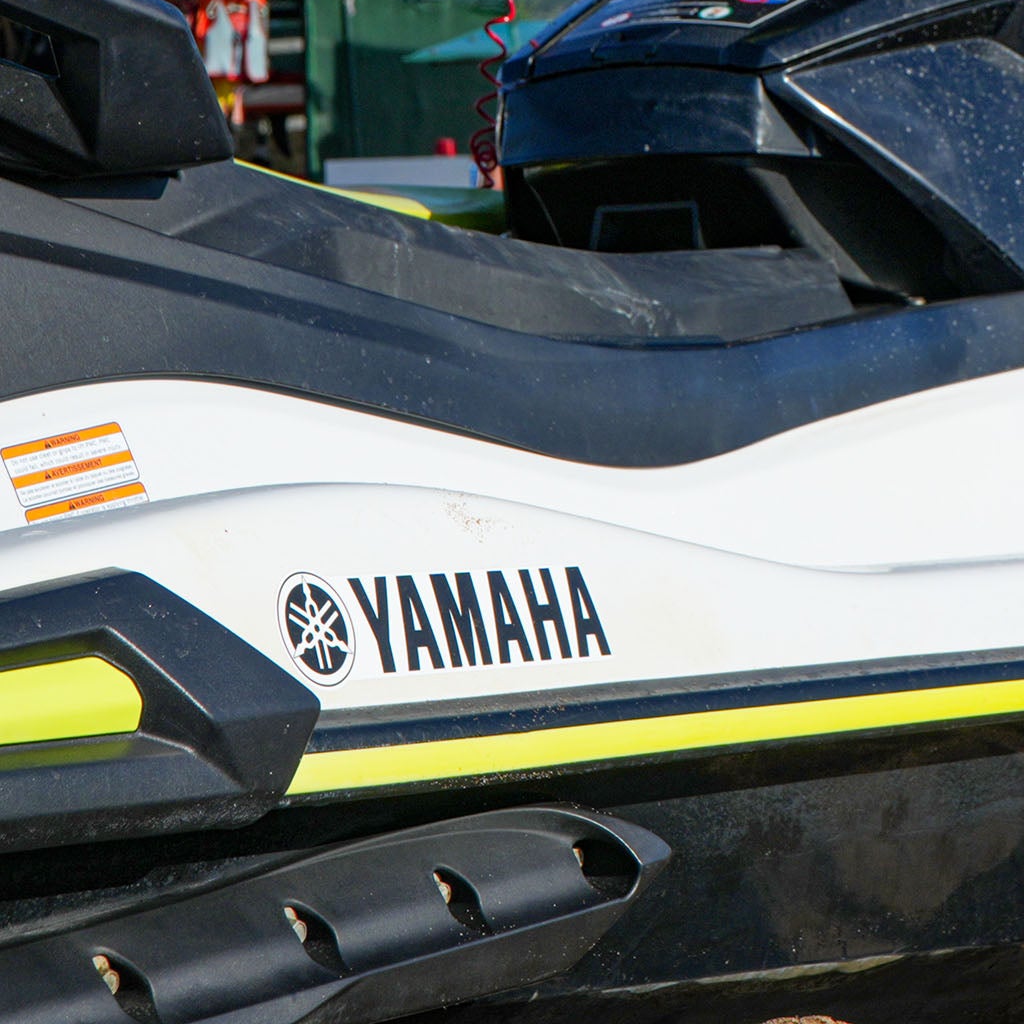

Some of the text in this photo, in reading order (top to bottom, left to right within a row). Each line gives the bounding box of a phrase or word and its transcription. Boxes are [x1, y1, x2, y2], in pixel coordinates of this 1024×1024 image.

[51, 434, 80, 447] WARNING
[51, 459, 102, 477] AVERTISSEMENT
[76, 495, 104, 507] WARNING
[347, 566, 612, 674] YAMAHA
